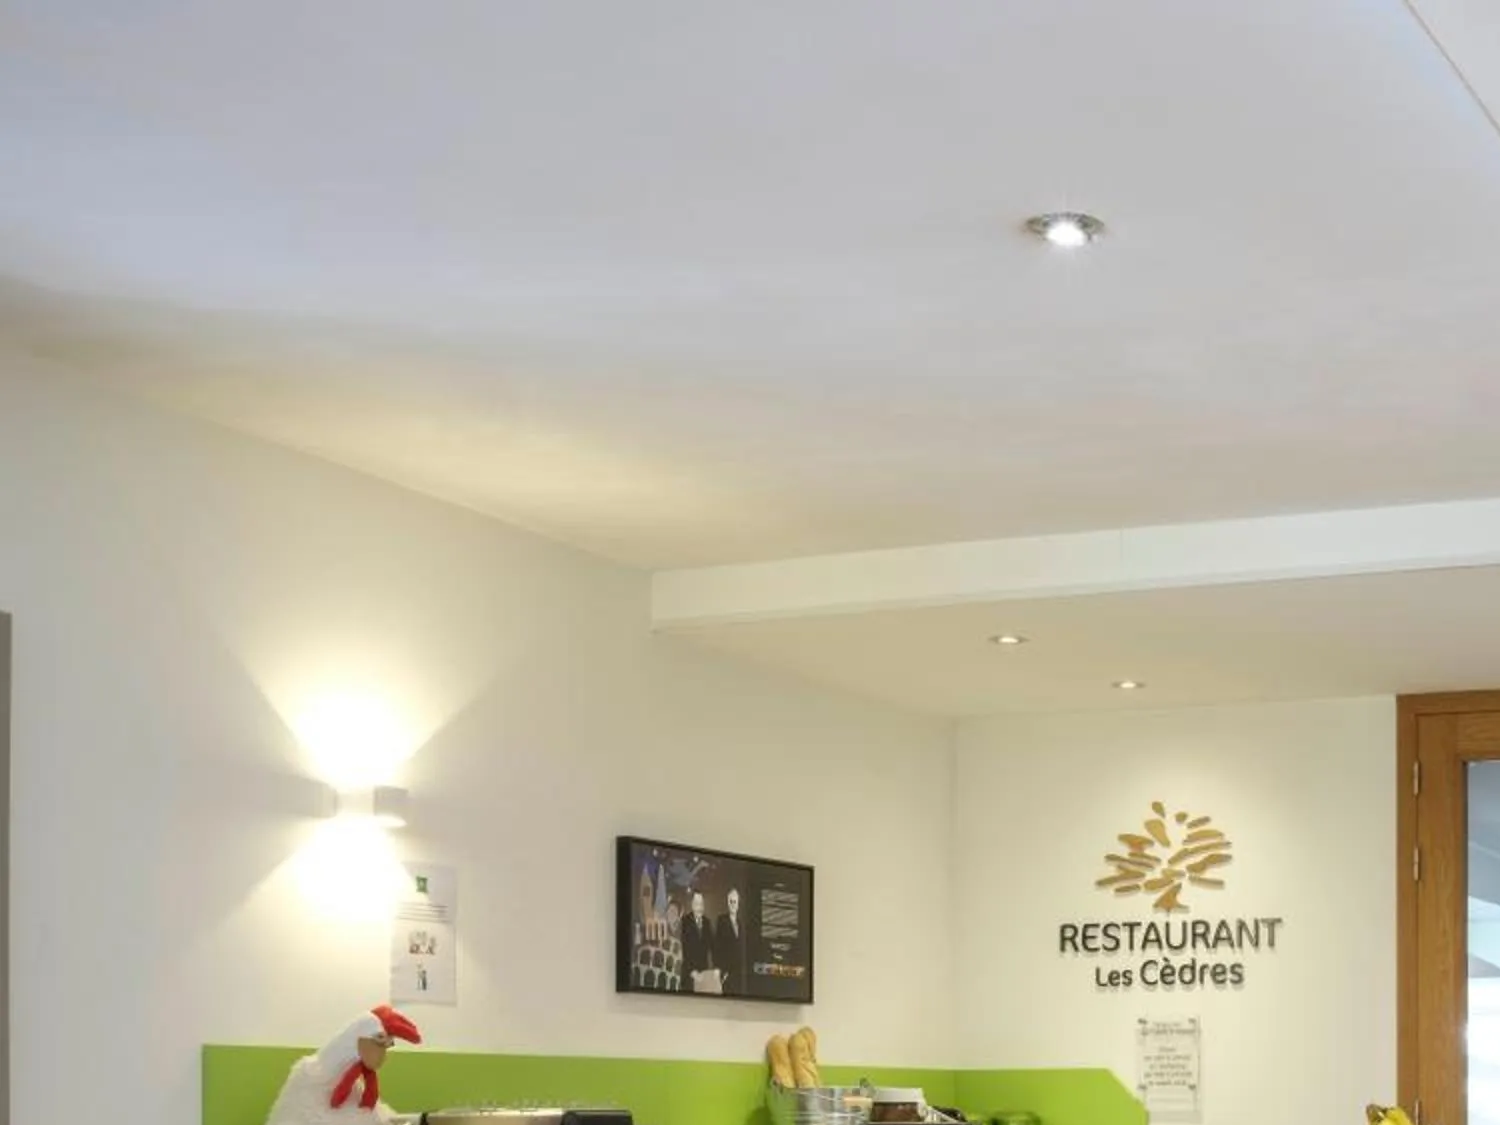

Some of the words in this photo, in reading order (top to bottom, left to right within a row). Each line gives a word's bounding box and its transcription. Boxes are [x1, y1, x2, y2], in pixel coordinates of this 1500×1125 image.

[1059, 918, 1283, 953] RESTAURANT
[1095, 966, 1134, 987] Les
[1139, 957, 1245, 986] Cèdres
